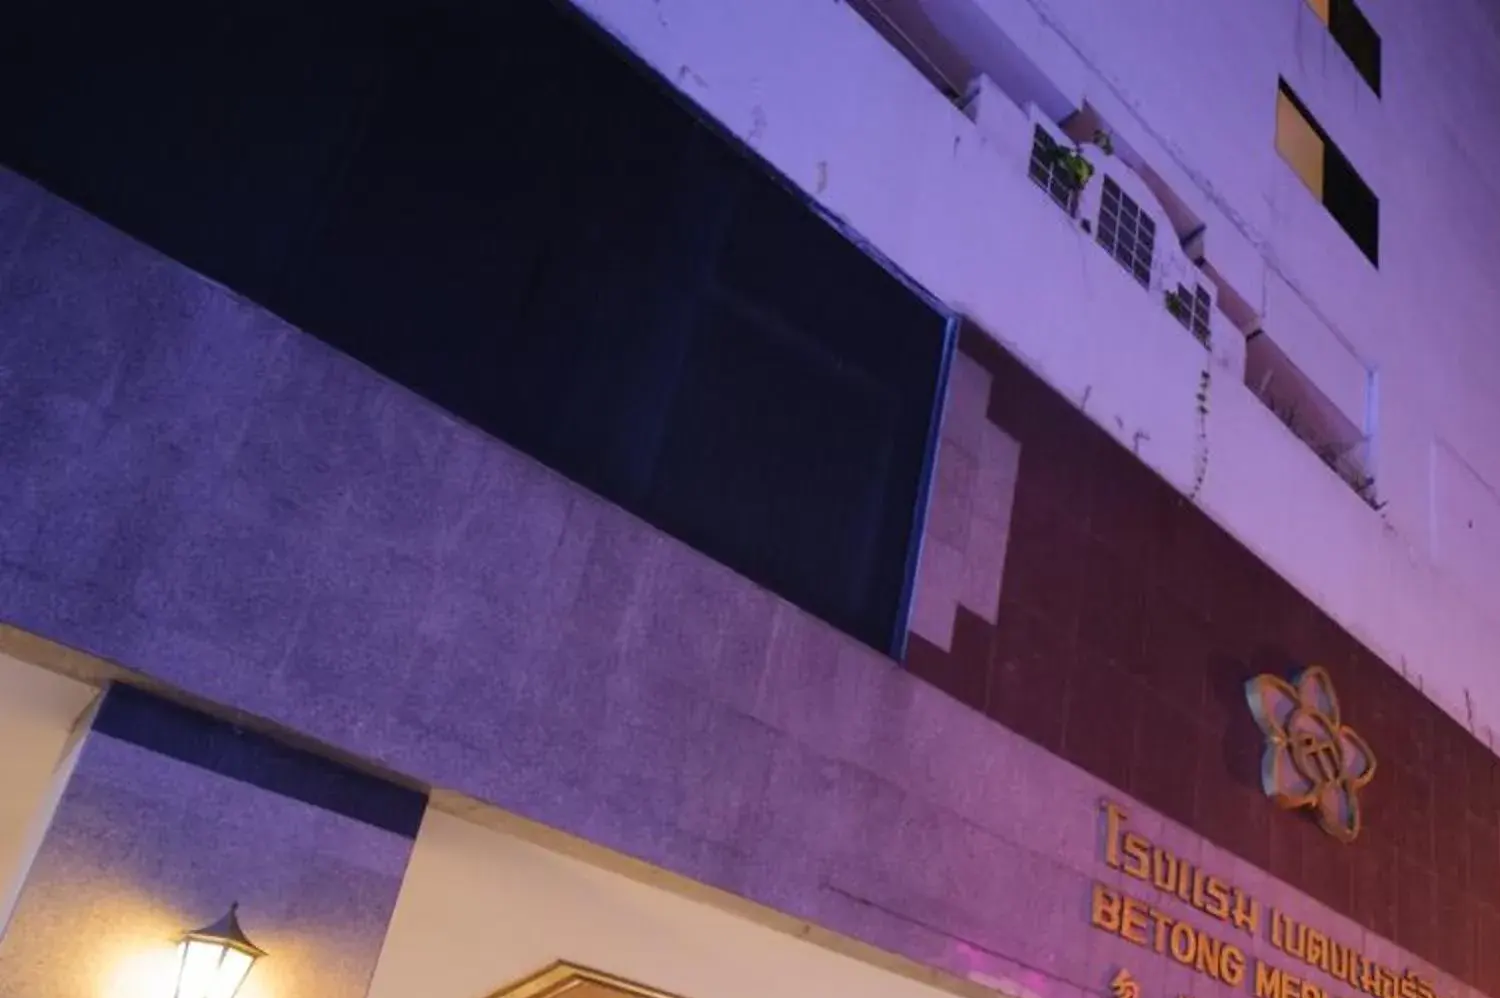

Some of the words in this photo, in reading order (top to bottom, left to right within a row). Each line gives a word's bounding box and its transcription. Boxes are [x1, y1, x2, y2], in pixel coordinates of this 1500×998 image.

[1101, 801, 1259, 933] โรงแรม
[1092, 881, 1246, 988] BETONG
